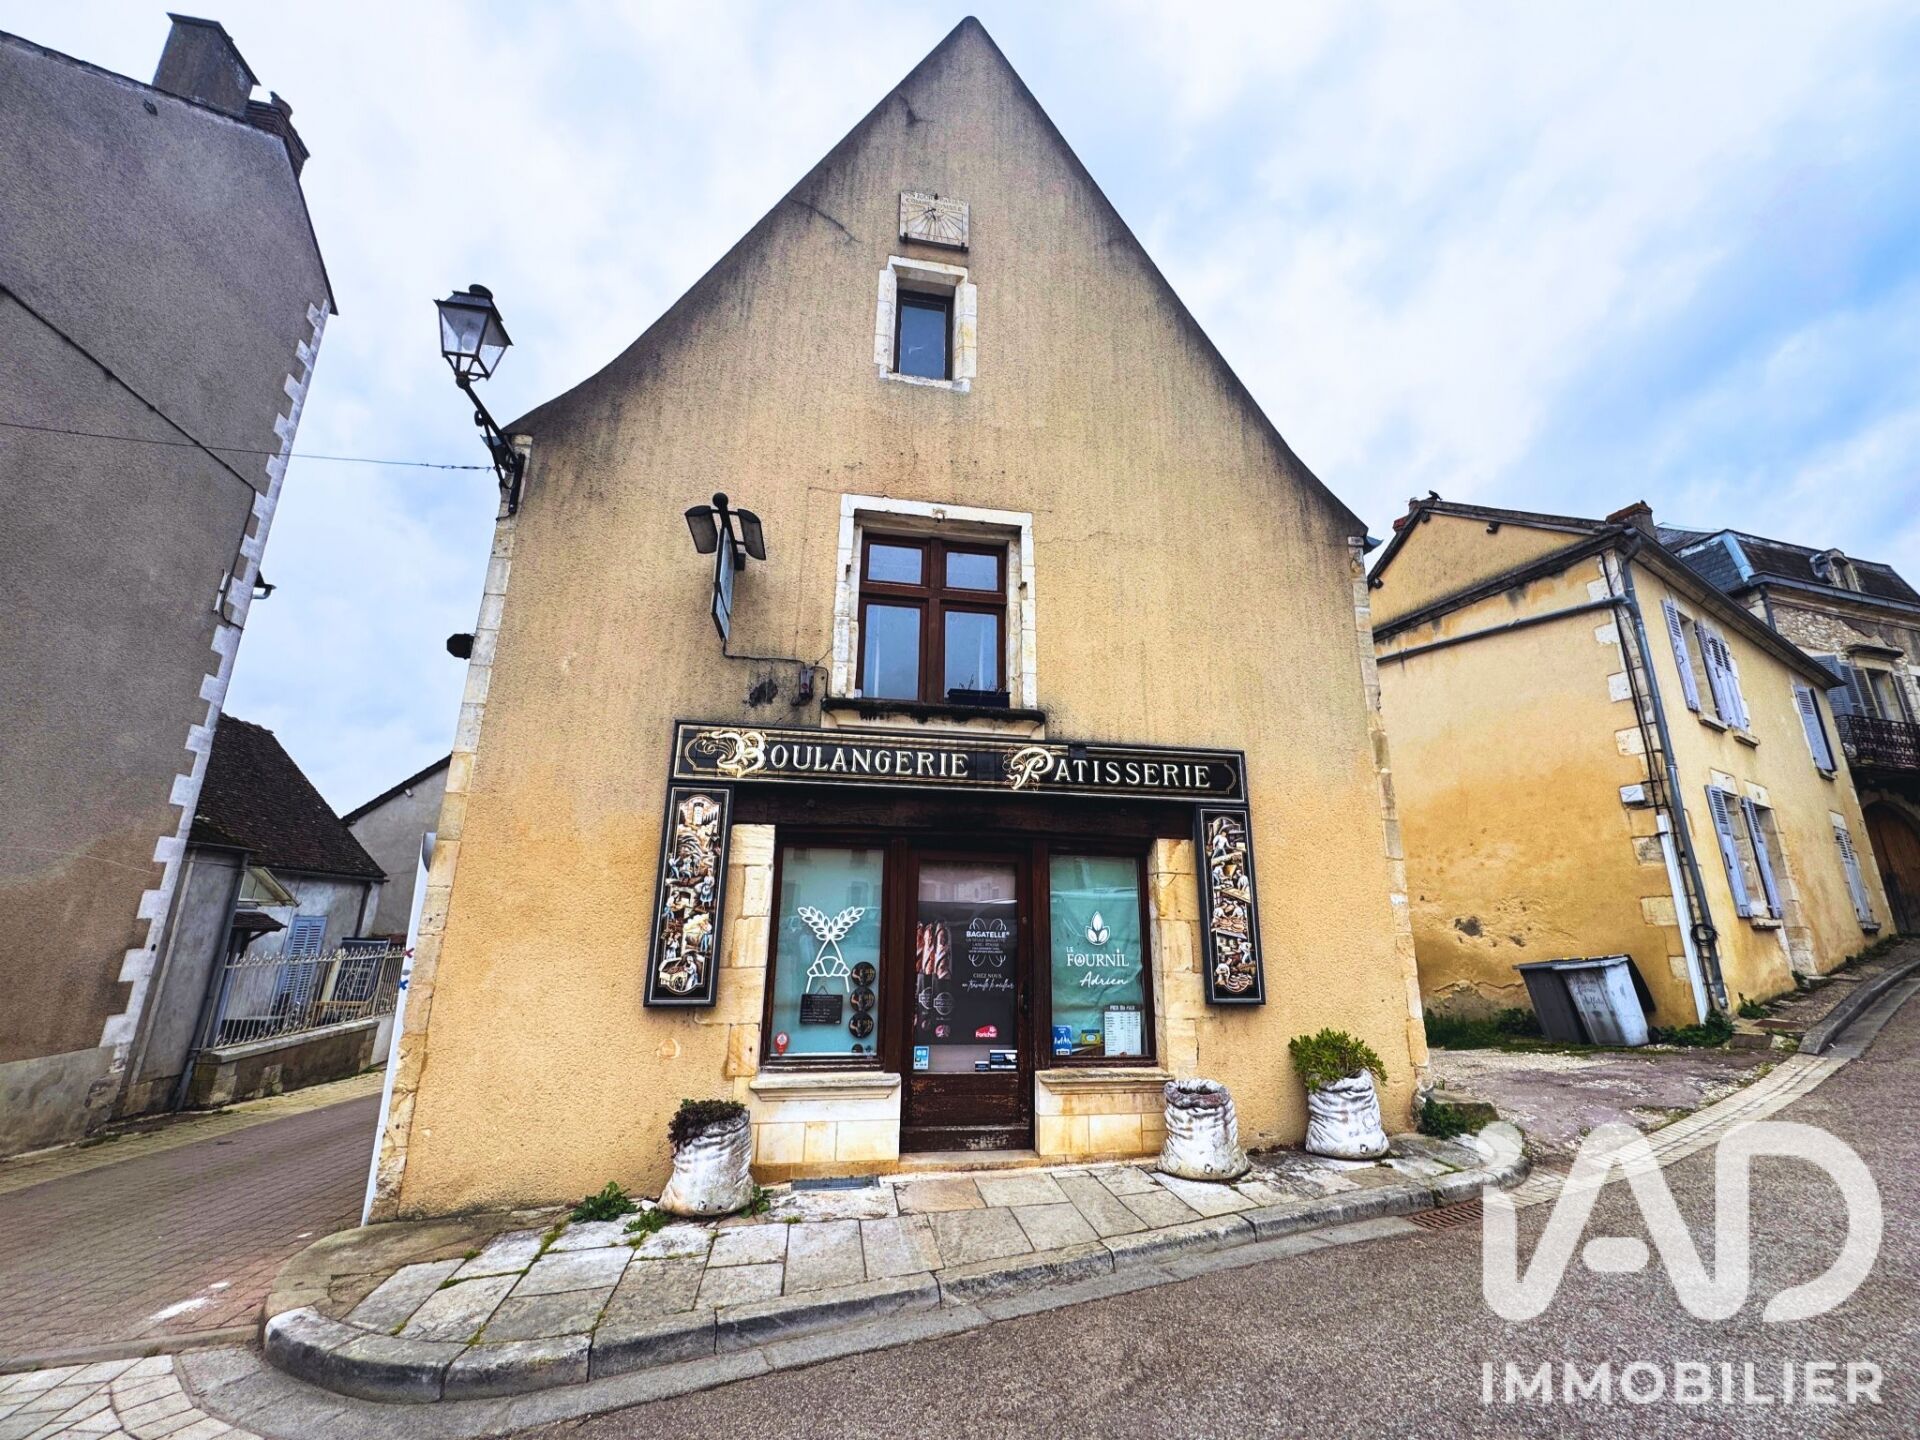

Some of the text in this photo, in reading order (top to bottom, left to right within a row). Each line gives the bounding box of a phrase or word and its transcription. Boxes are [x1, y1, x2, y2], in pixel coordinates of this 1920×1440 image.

[703, 731, 1211, 790] BOULANGERIE PATISSERIE
[1066, 948, 1130, 967] FOURNIL
[1080, 971, 1129, 988] Adrien
